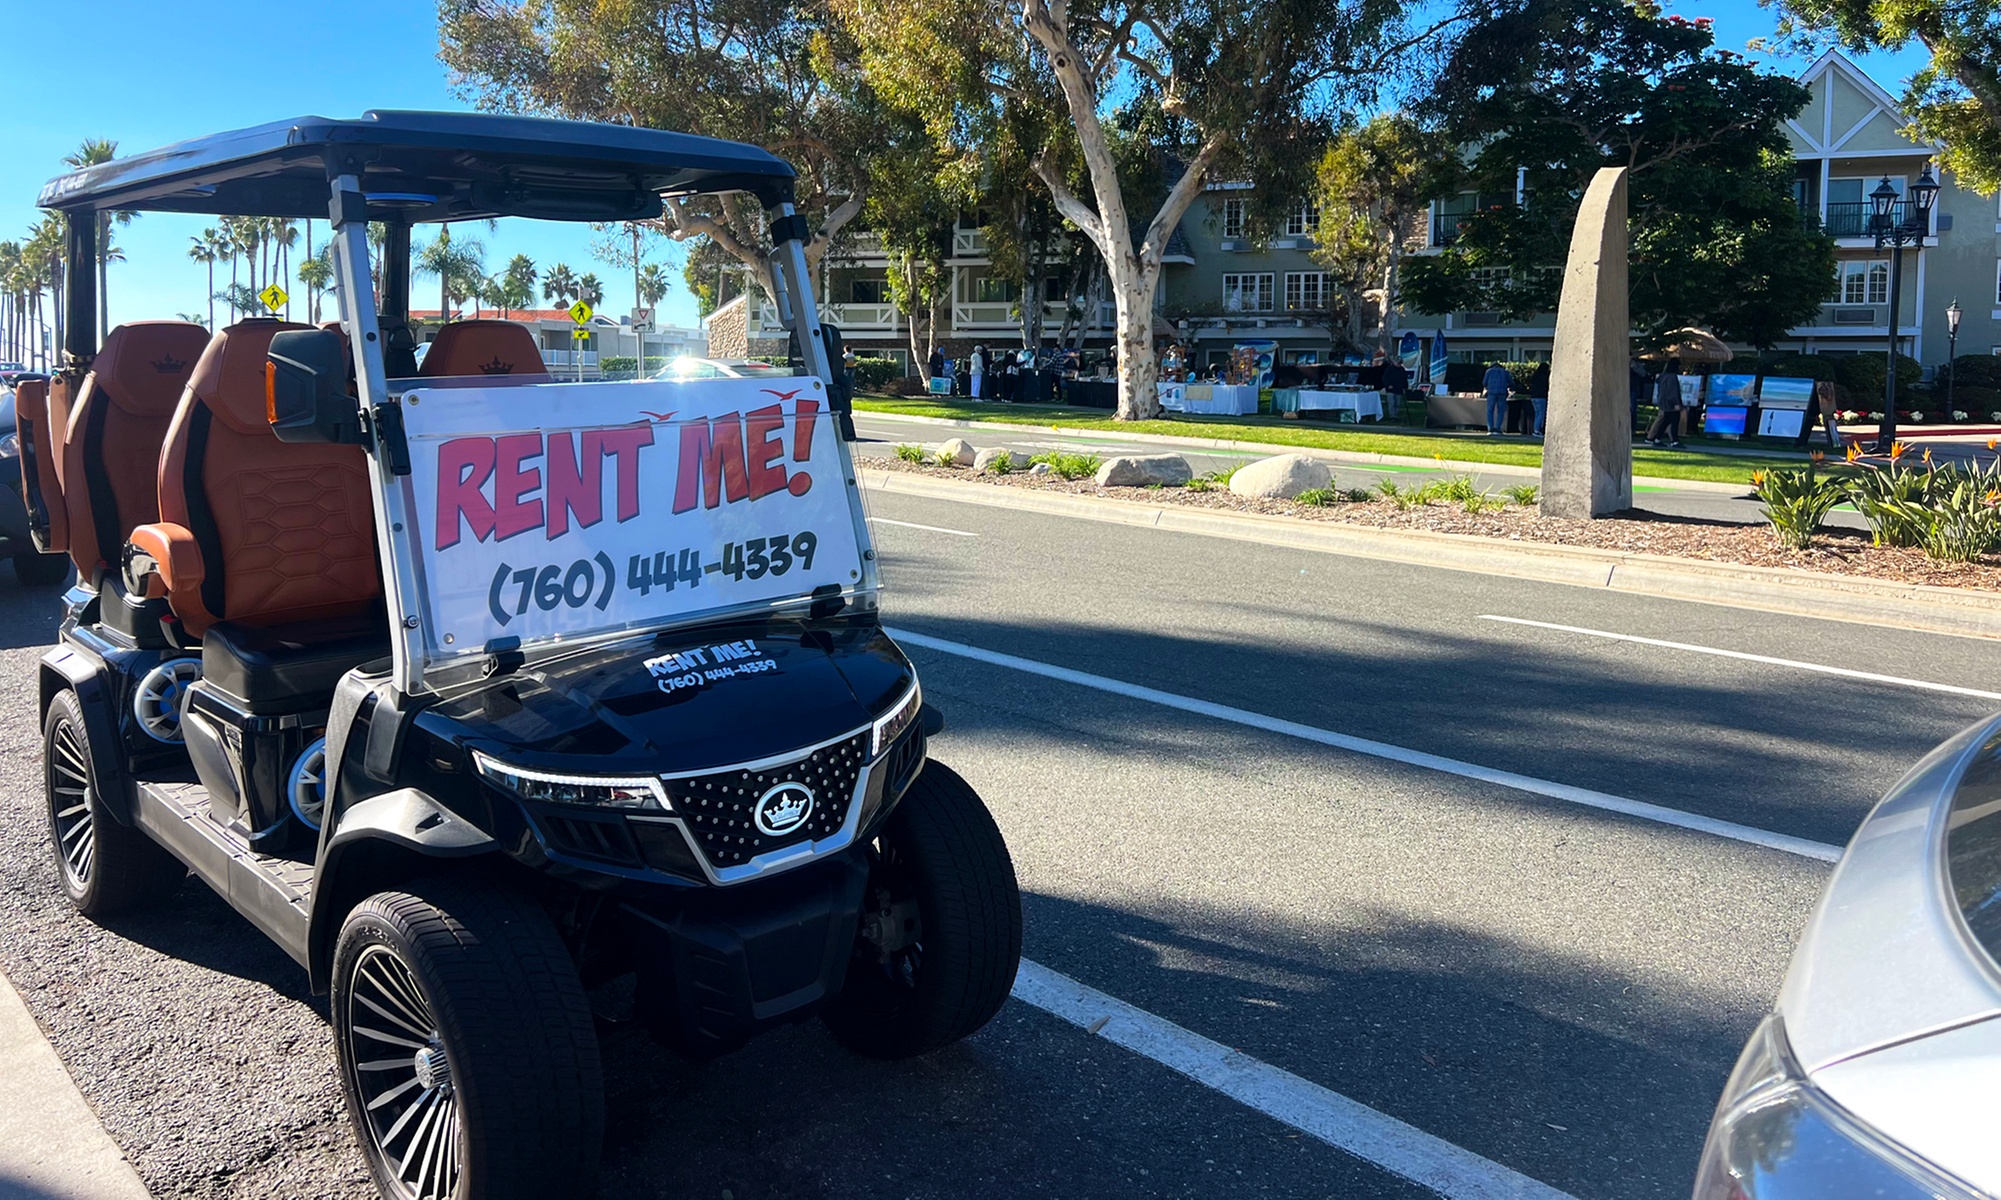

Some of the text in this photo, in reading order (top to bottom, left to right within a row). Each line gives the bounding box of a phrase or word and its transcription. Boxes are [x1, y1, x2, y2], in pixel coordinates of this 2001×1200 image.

[436, 399, 819, 552] RENT ME!
[489, 550, 616, 627] (760)
[627, 531, 817, 596] 444-4339
[643, 639, 761, 677] RENT ME!
[658, 659, 777, 694] (760) 444-4339
